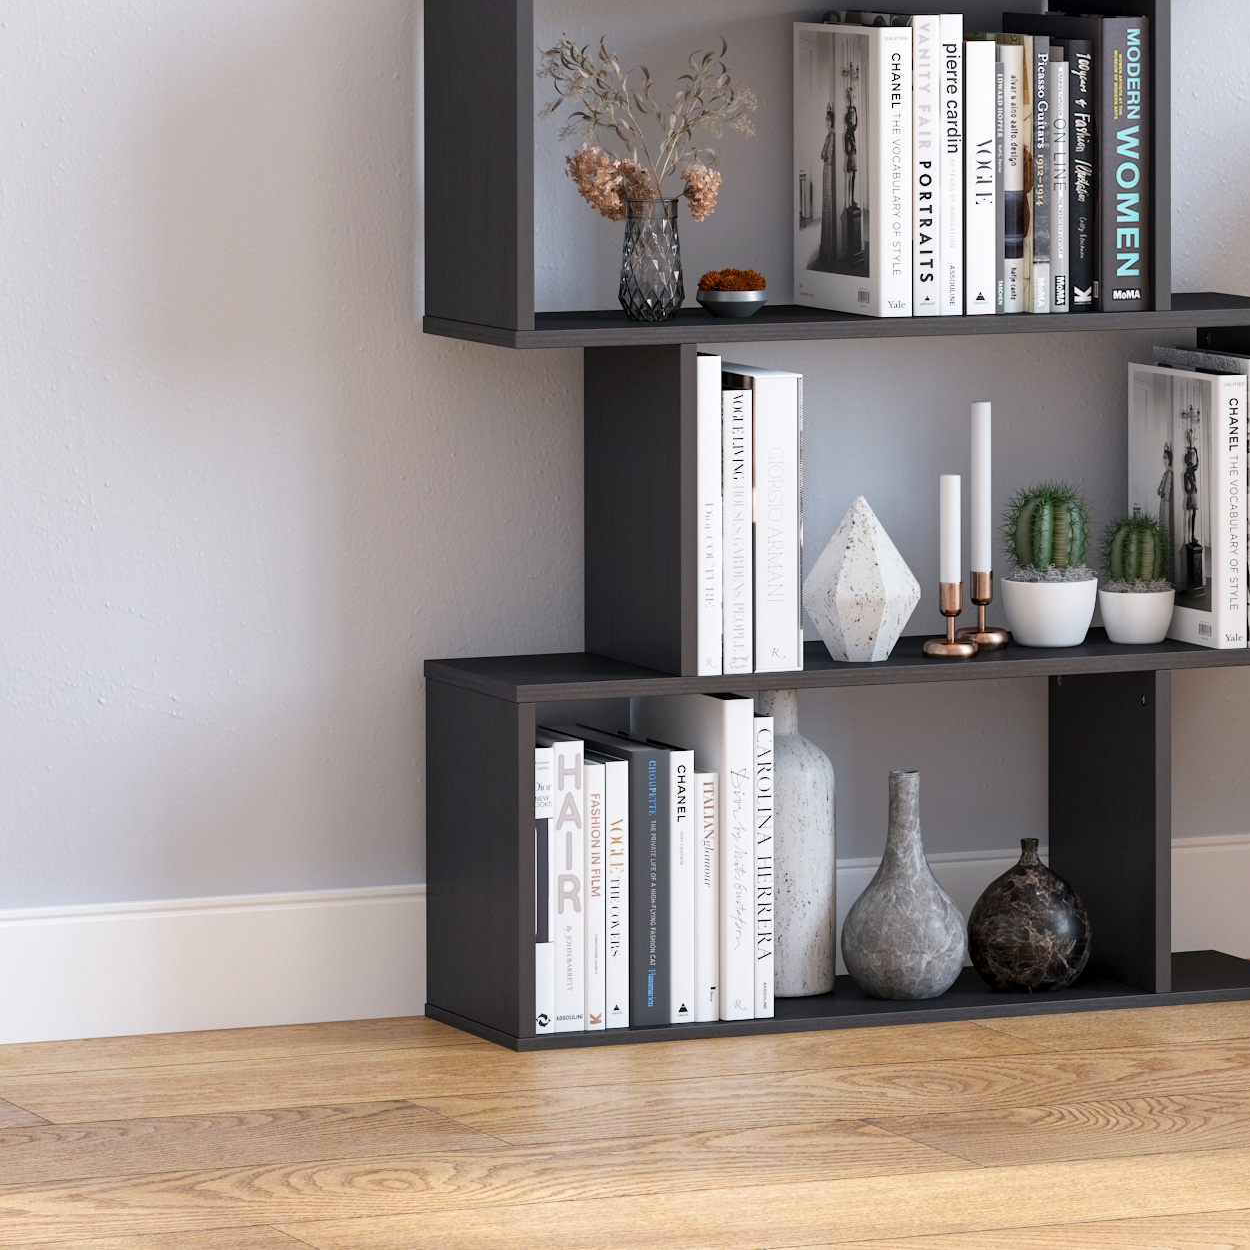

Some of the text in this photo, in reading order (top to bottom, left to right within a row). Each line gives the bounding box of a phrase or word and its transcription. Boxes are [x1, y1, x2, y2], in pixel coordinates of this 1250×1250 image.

[942, 43, 962, 154] pierre cardin
[1037, 53, 1049, 99] Picasso
[918, 22, 934, 283] VANITY FAIR PORTRAITS
[1037, 100, 1049, 149] Guitars
[1053, 118, 1067, 191] ON LINE
[1073, 112, 1091, 153] Fashion
[1116, 28, 1142, 277] MODERN WOMEN
[975, 139, 993, 205] VOGUE
[1113, 289, 1141, 300] MoMA
[766, 447, 784, 603] GIORGIO ARMANI
[648, 760, 657, 816] CHOUPETTE
[677, 764, 686, 823] CHANEL
[556, 753, 583, 915] HAIR
[591, 793, 601, 897] FASHION IN FILM
[610, 818, 624, 874] VOGUE
[701, 781, 715, 888] ITALIAN glamour
[756, 728, 772, 961] CAROLINA HERRERA
[610, 906, 621, 958] COVERS
